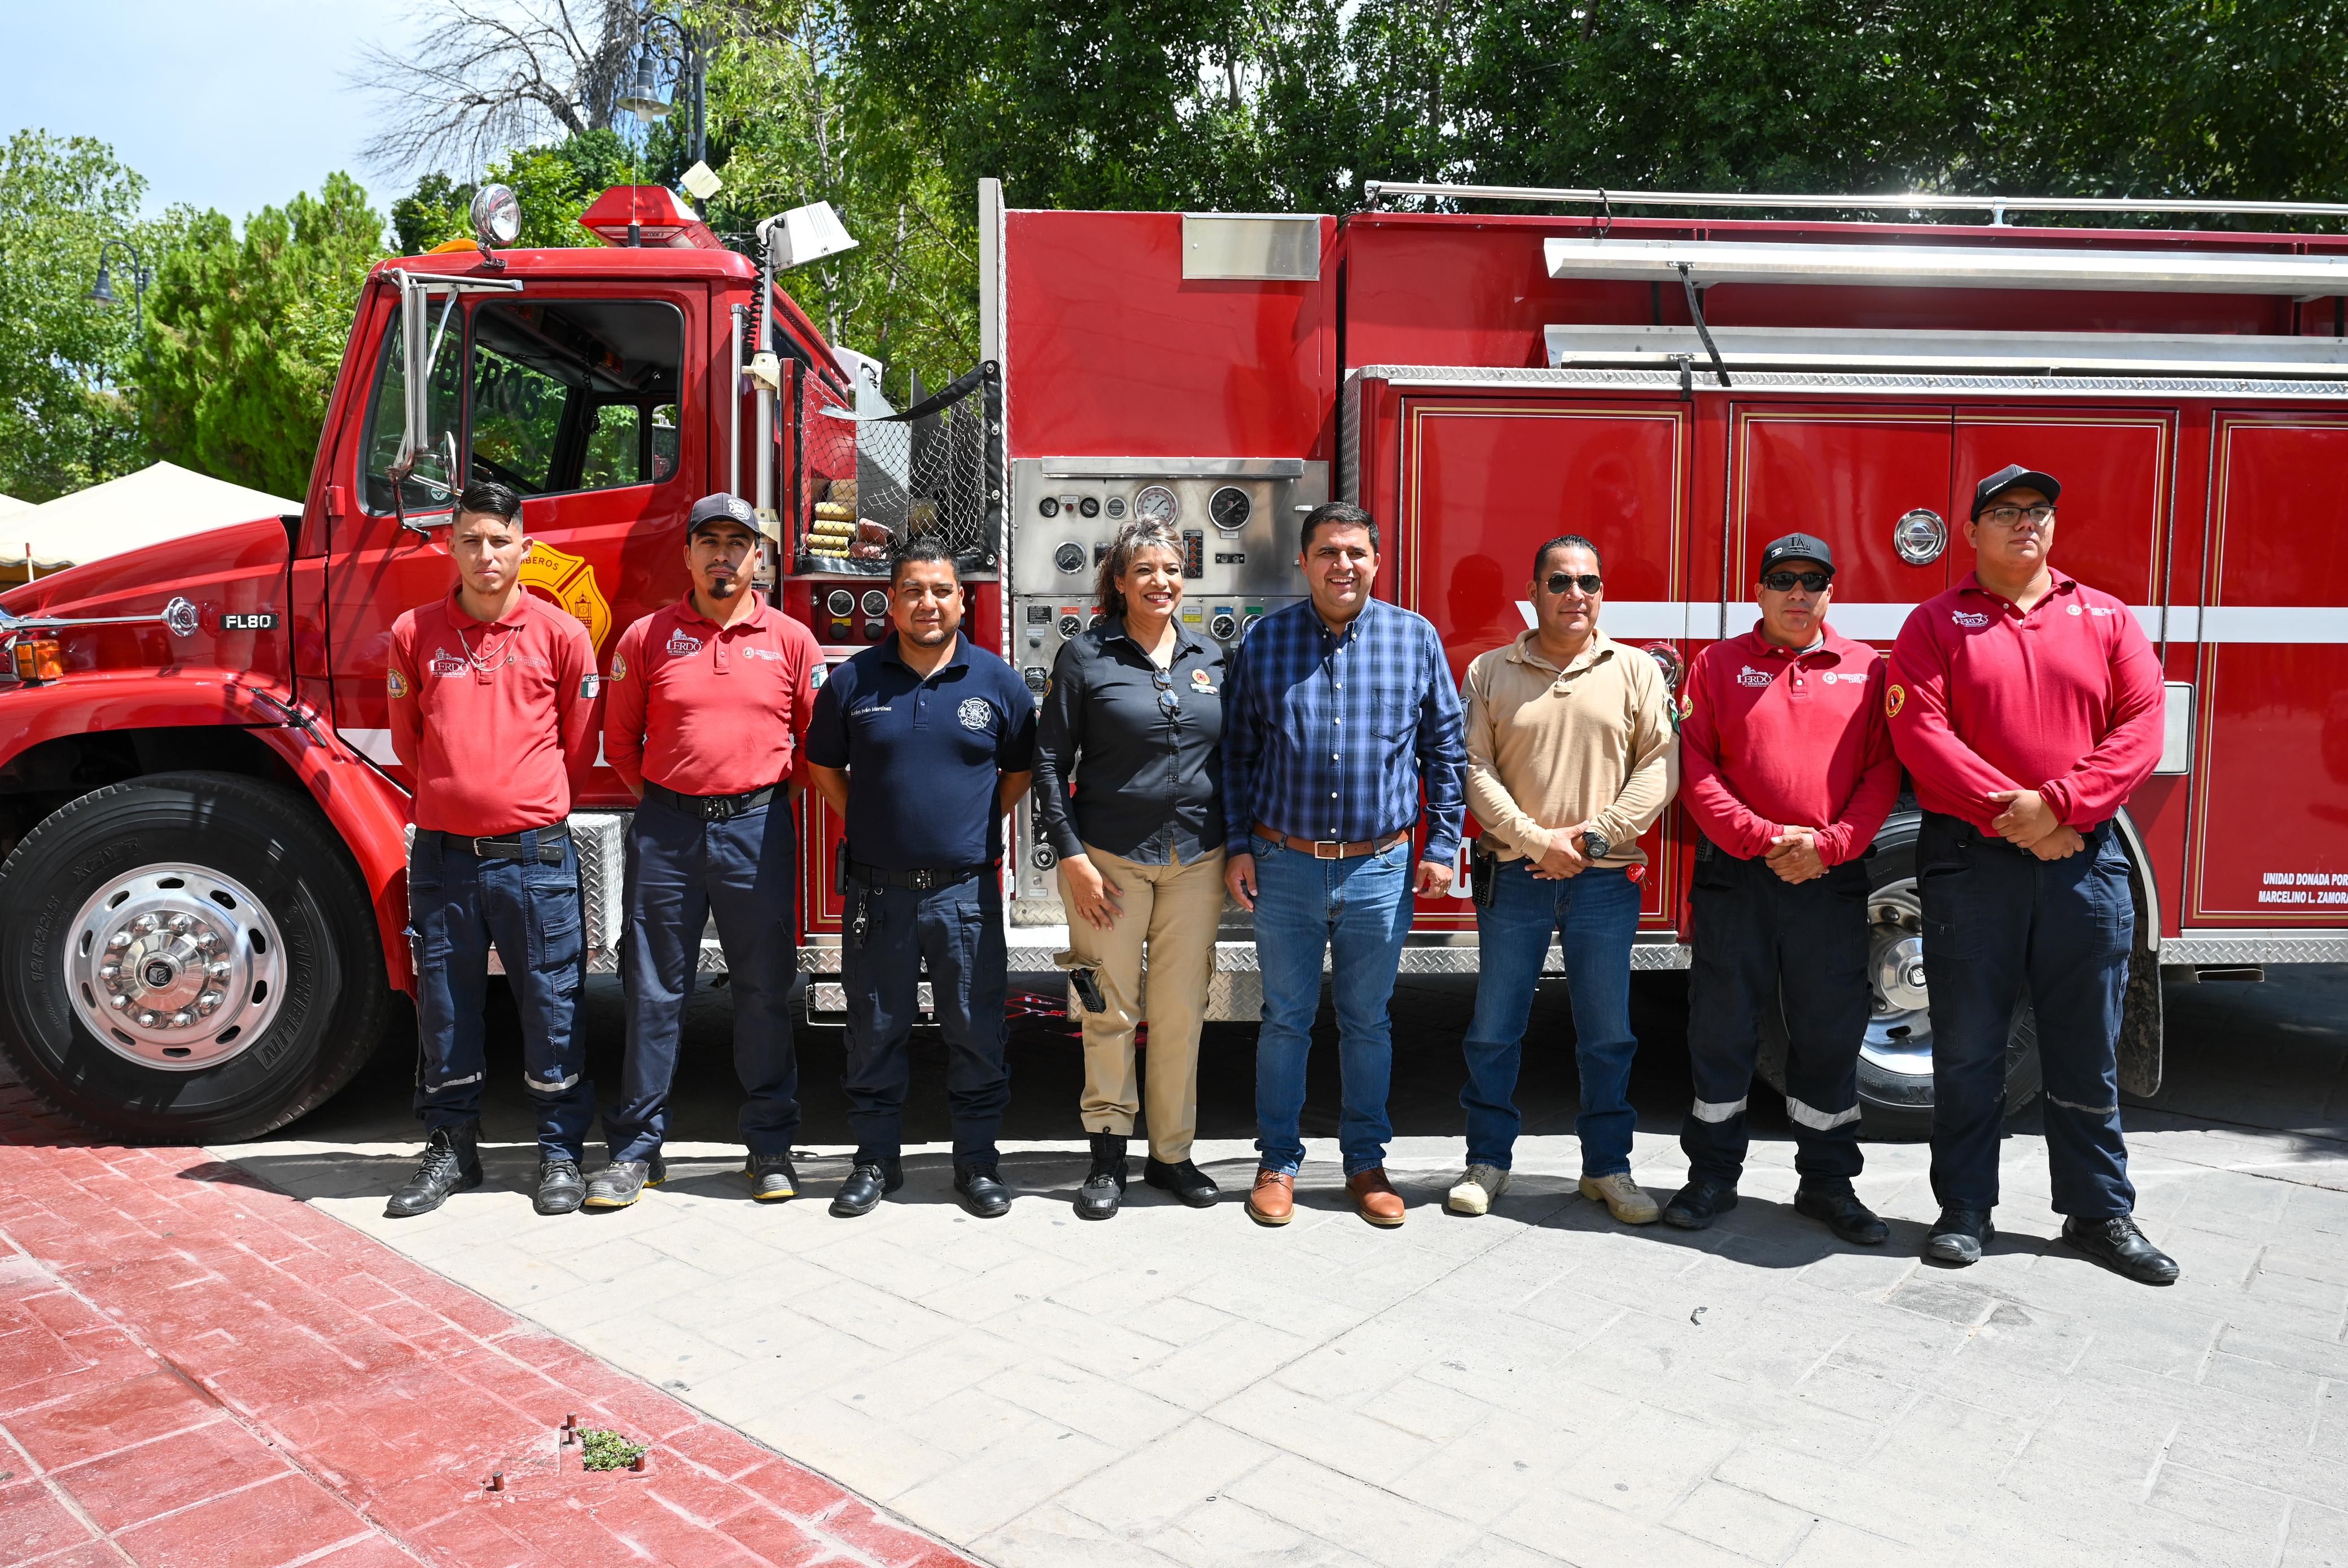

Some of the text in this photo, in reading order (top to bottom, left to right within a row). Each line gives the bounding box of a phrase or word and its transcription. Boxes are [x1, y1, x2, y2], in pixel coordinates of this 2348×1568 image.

[226, 615, 271, 628] FL80
[1952, 616, 1988, 625] LERDO
[667, 640, 702, 651] LERDO
[430, 661, 469, 672] LERDO
[1737, 674, 1772, 683] LERDO
[2263, 873, 2348, 886] UNIDAD DONADA POR
[2258, 891, 2307, 903] MARCELINO
[2308, 891, 2315, 903] L.
[262, 929, 312, 1066] MICHELIN
